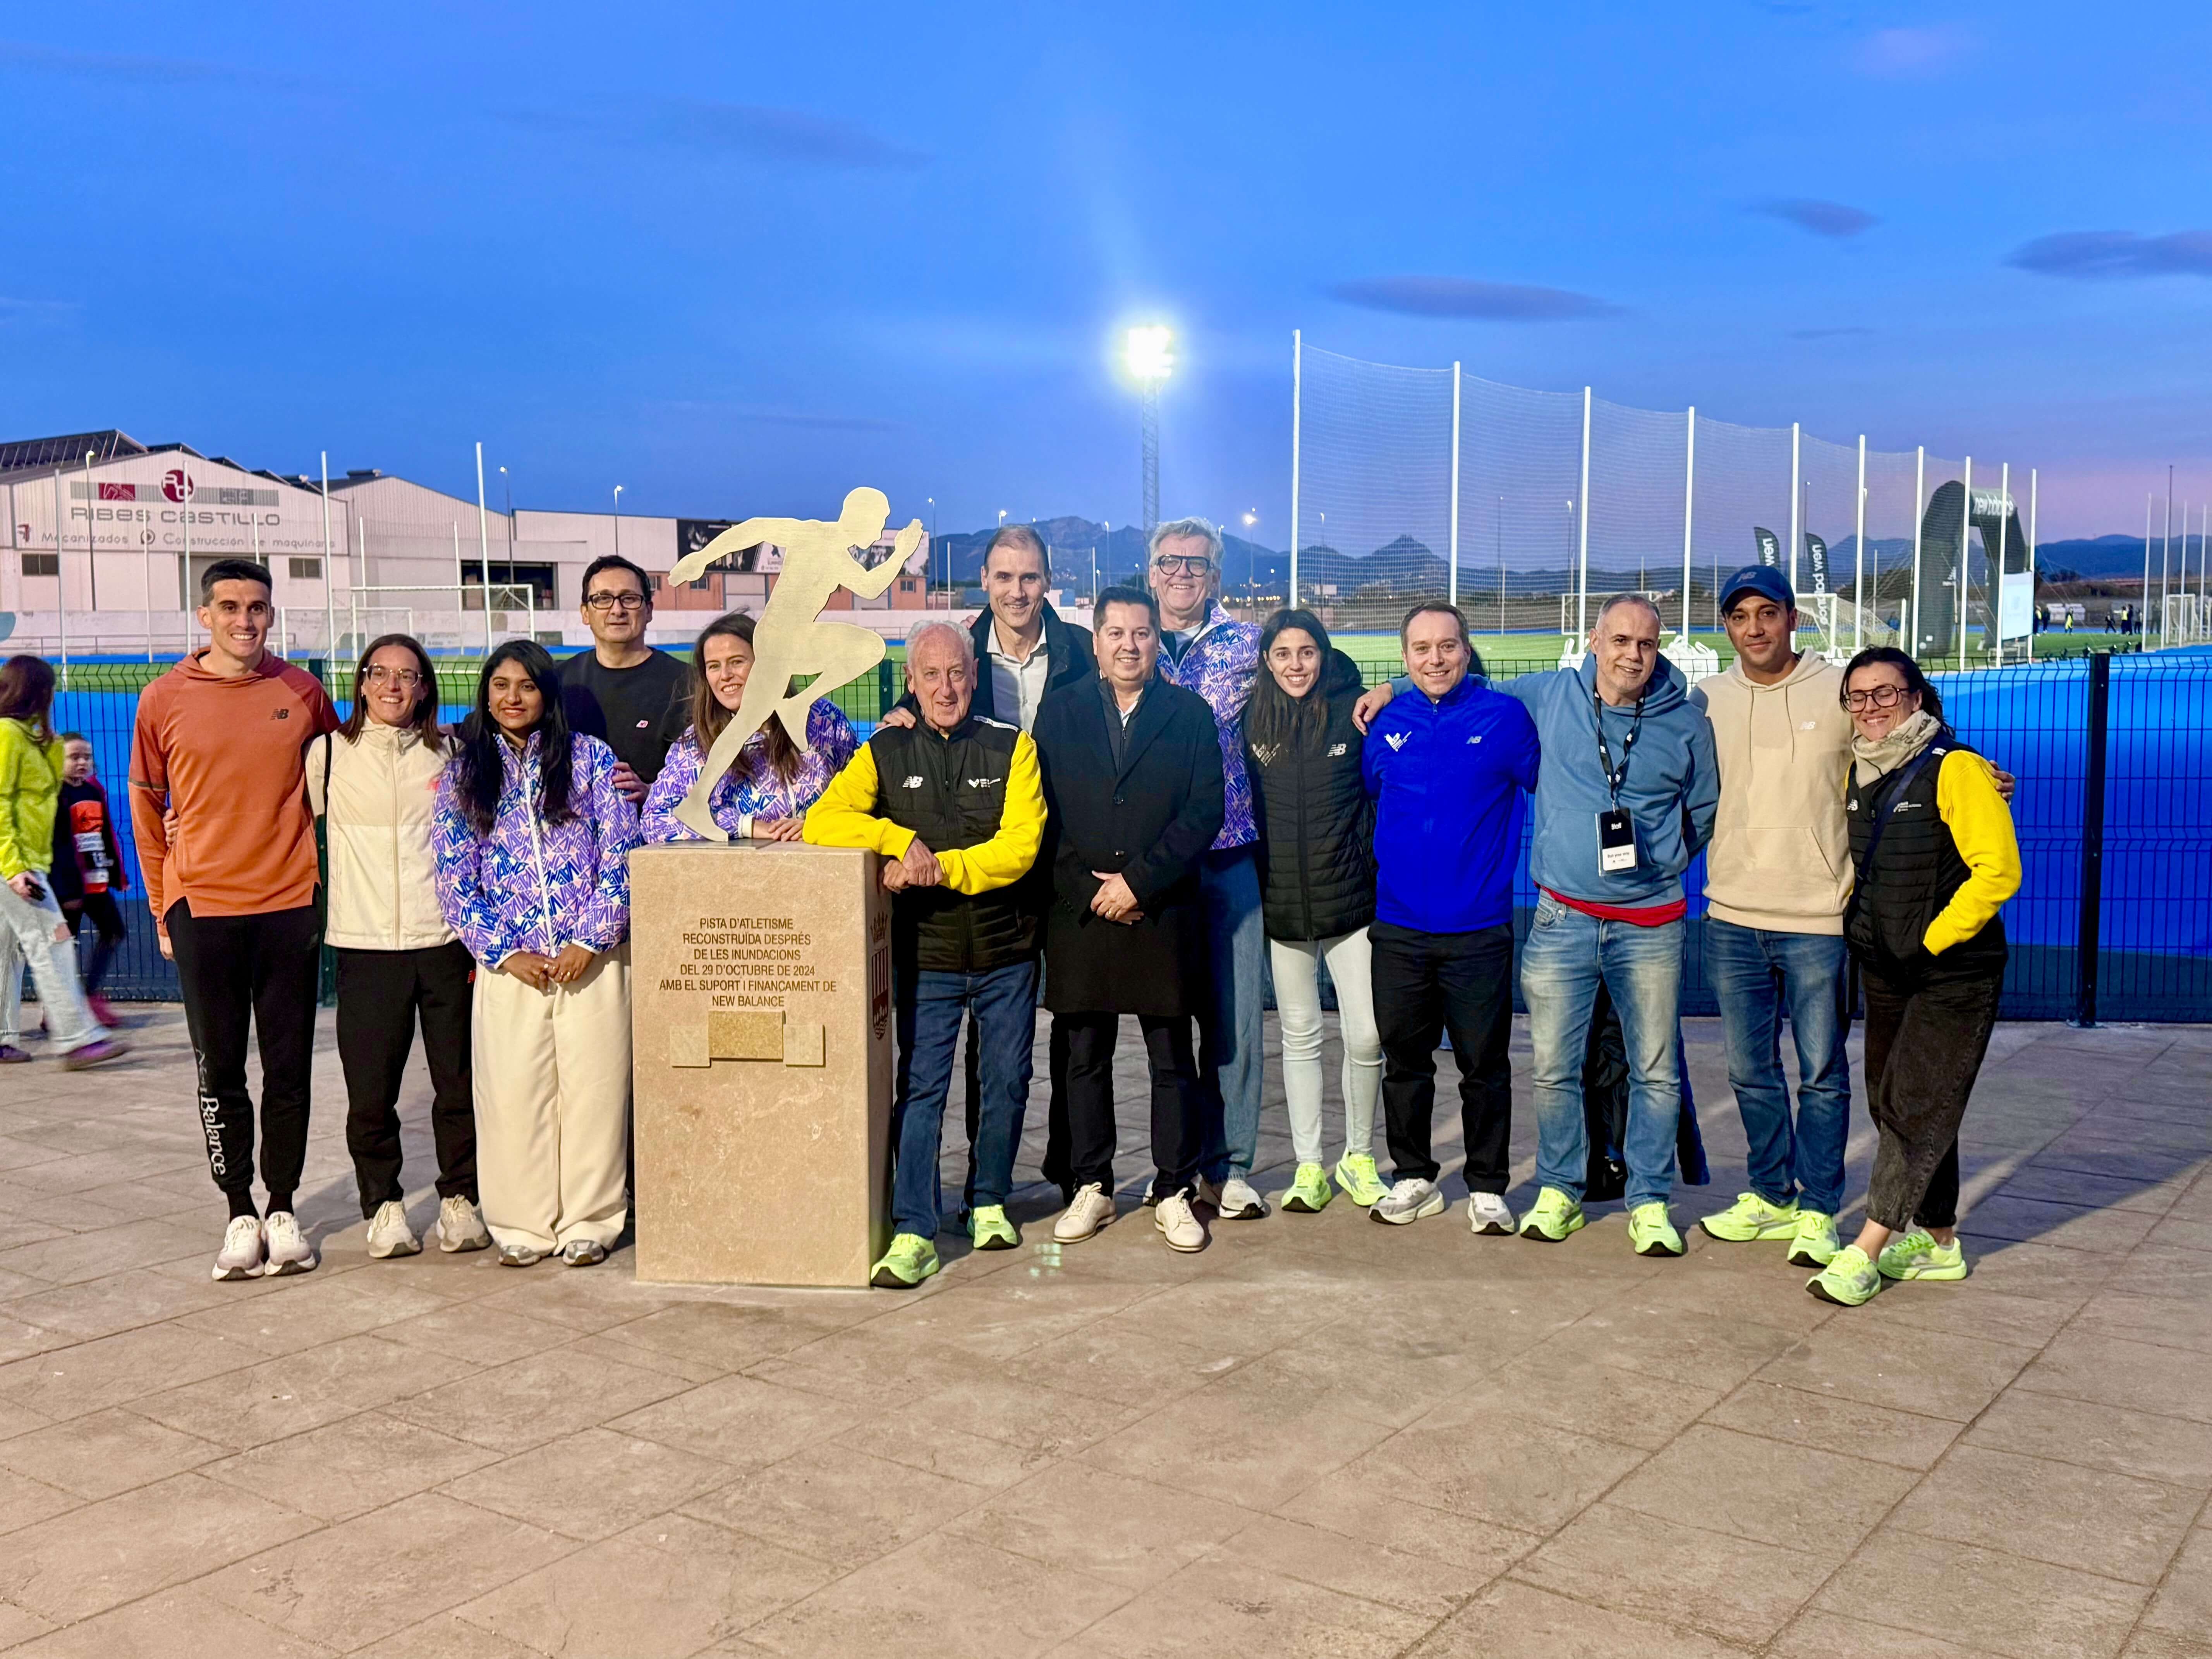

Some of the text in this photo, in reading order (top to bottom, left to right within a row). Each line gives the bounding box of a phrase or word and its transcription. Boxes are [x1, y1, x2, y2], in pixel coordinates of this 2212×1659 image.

[163, 532, 244, 546] Costrucción
[273, 539, 335, 549] maquinara
[1327, 743, 1346, 757] NB
[902, 776, 923, 788] NB
[700, 918, 793, 929] PISTA D'ATLETISME
[683, 931, 811, 945] RECONSTRUÏDA DESPRÉS
[694, 949, 801, 960] DE LES INUNDACIONS
[680, 964, 815, 976] DEL 29 D'OCTUBRE DE 2024
[659, 979, 837, 993] AMB EL SUPORT I FINANÇAMENT DE
[712, 995, 785, 1007] NEW BALANCE
[200, 1094, 226, 1175] Balance
